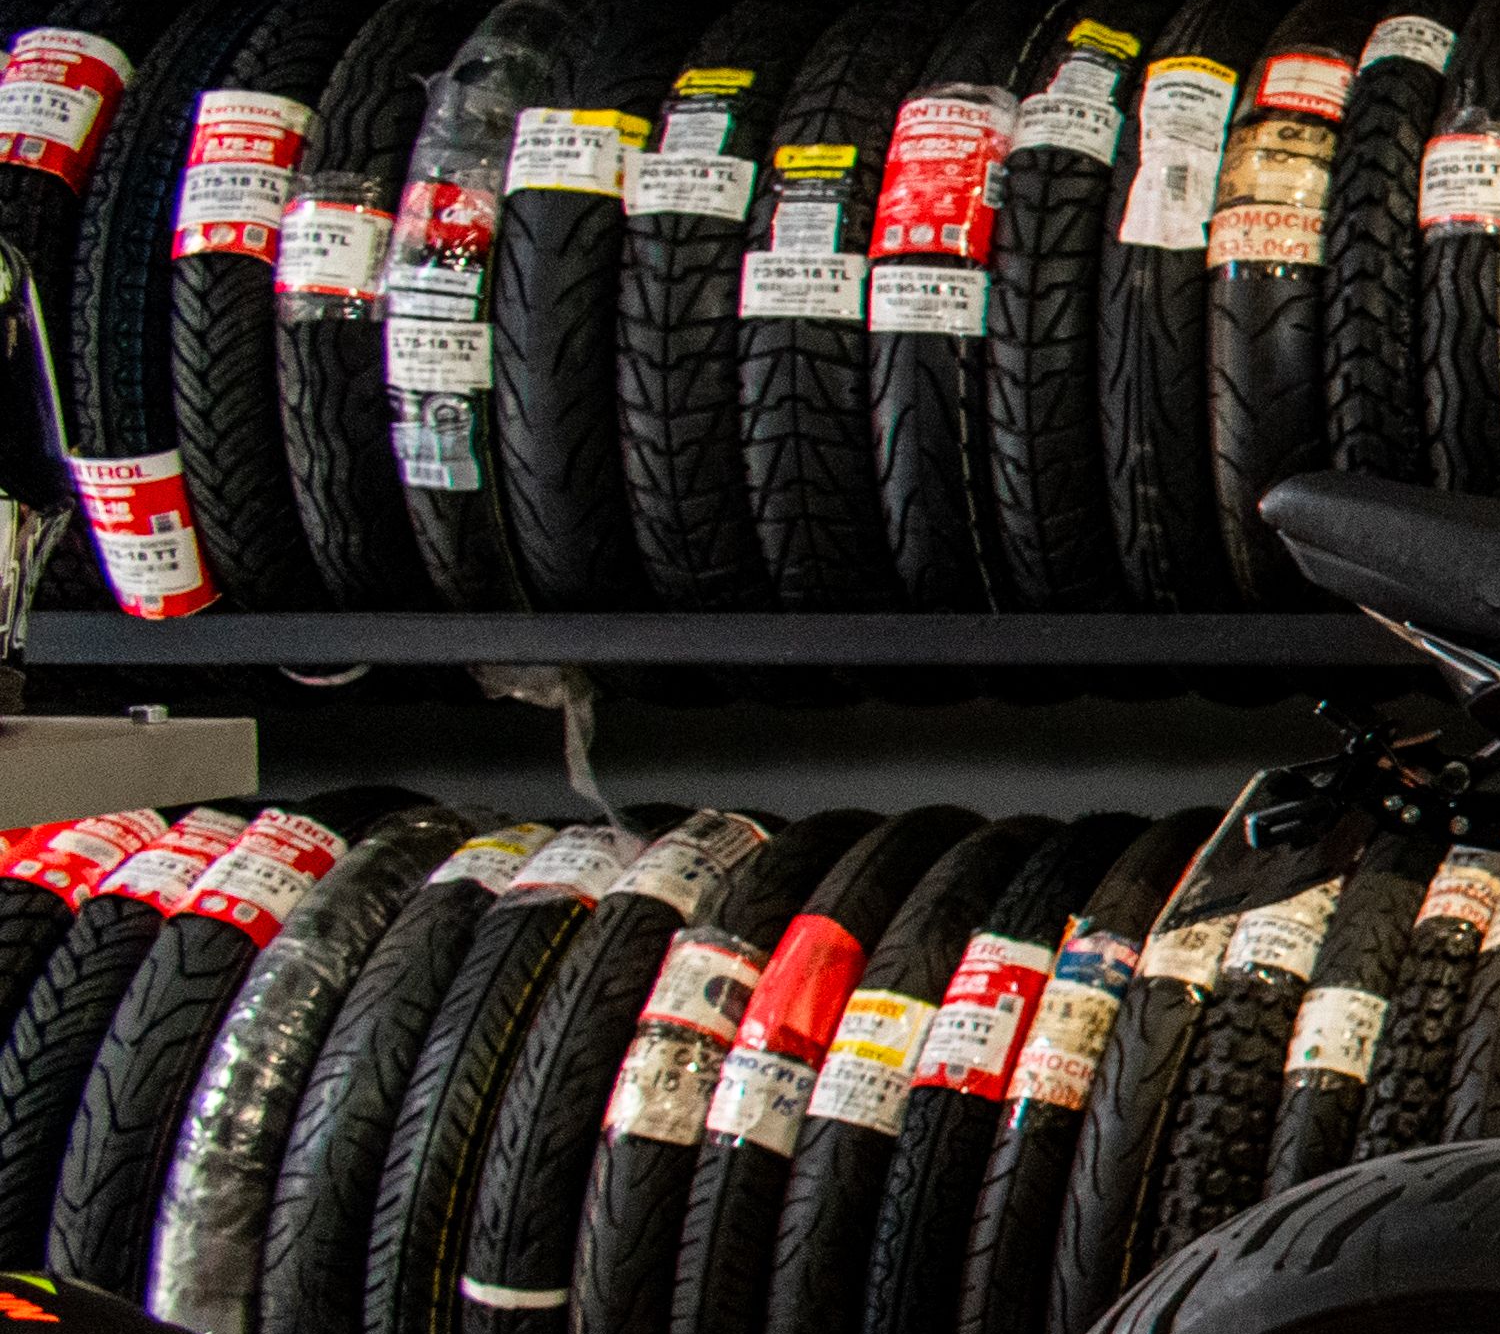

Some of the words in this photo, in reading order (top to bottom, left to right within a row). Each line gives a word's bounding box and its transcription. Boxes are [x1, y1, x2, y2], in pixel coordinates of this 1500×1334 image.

[259, 175, 281, 192] TL
[828, 268, 851, 282] TL
[456, 338, 480, 352] TL
